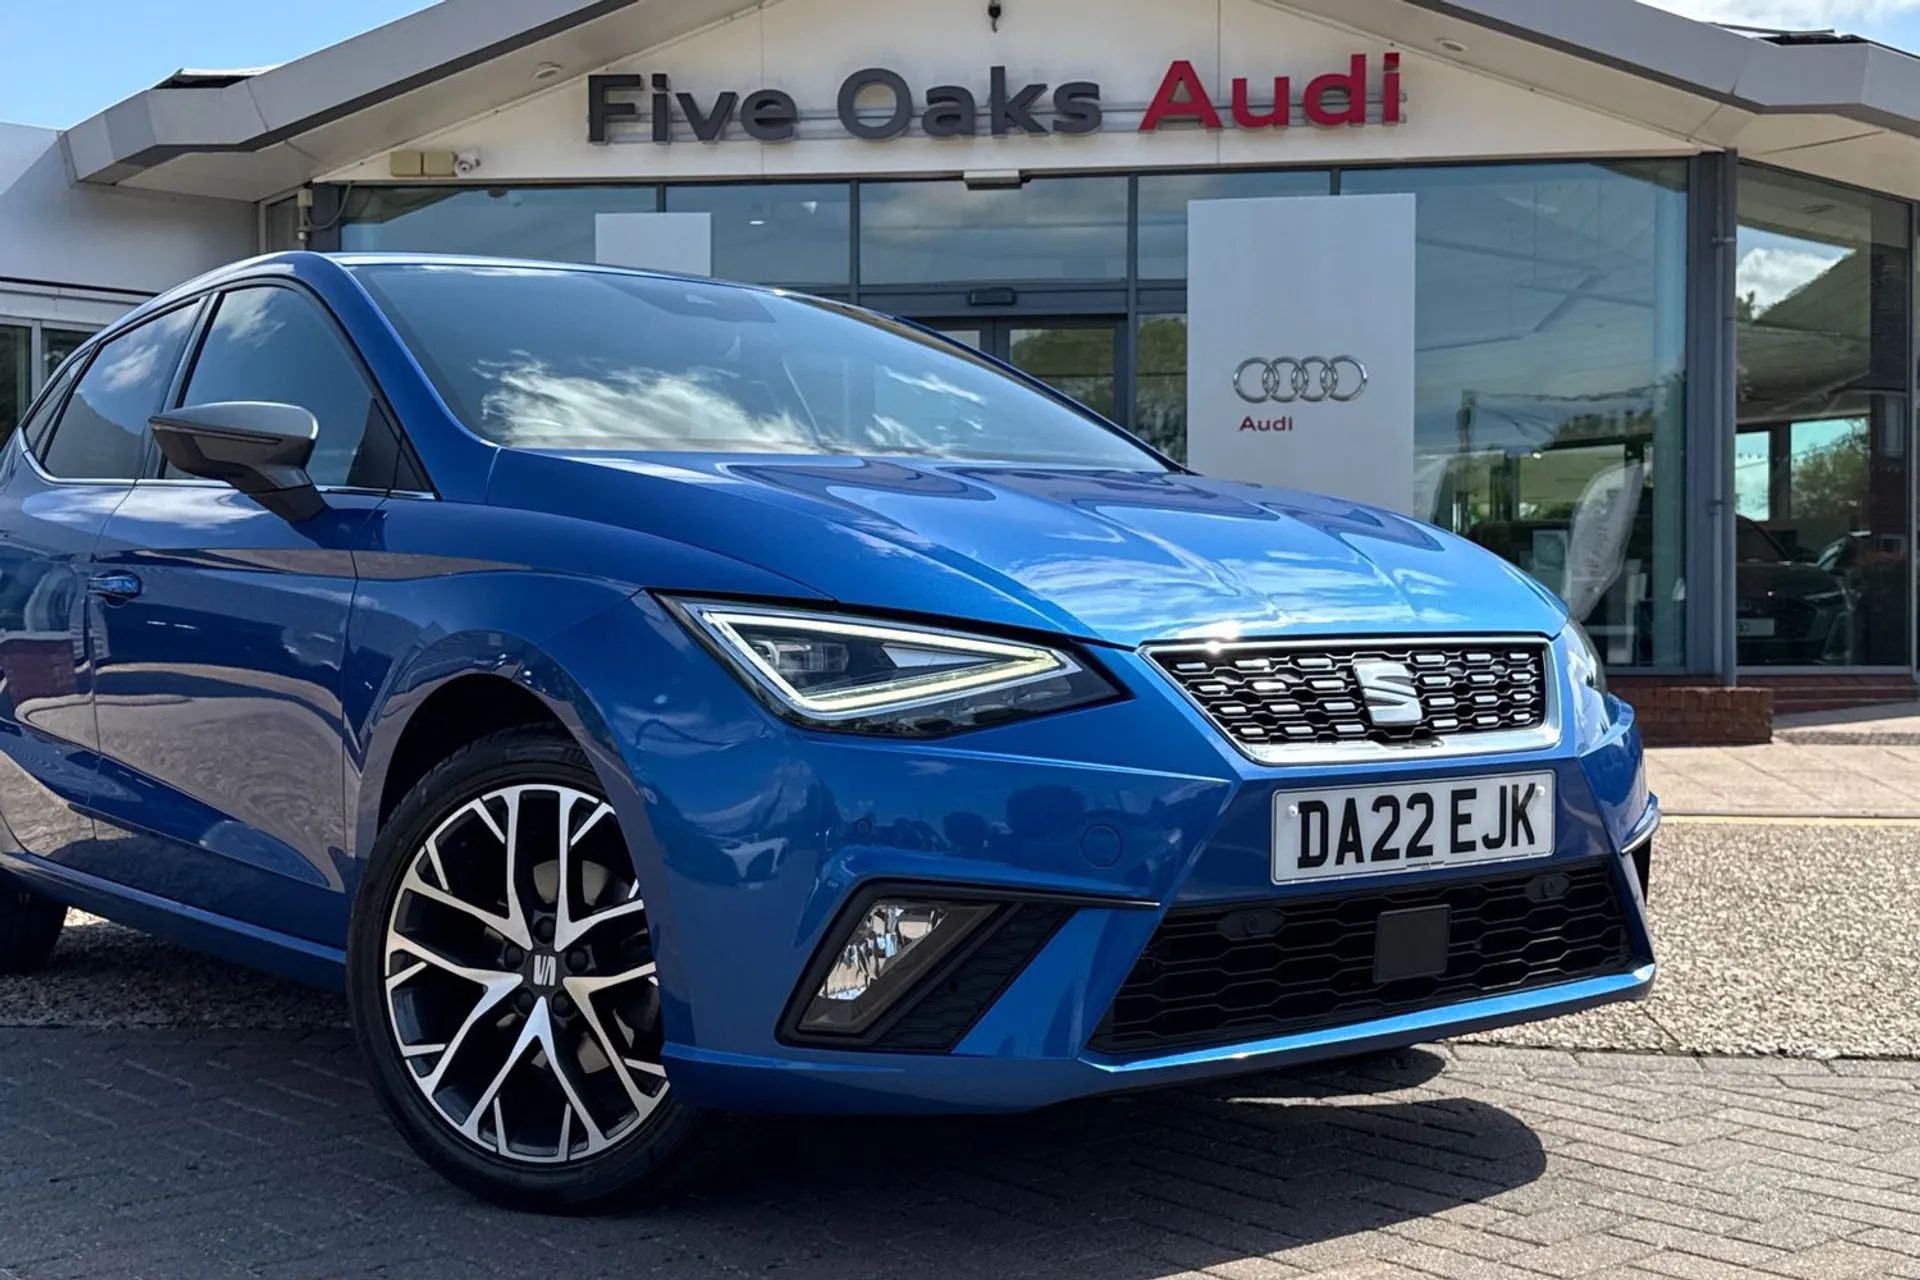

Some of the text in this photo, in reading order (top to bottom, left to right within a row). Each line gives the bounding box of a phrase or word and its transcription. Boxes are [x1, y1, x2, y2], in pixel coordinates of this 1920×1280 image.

[588, 52, 1400, 144] Five Oaks Audi
[1238, 416, 1293, 432] Audi
[1297, 783, 1536, 869] DA22 EJK
